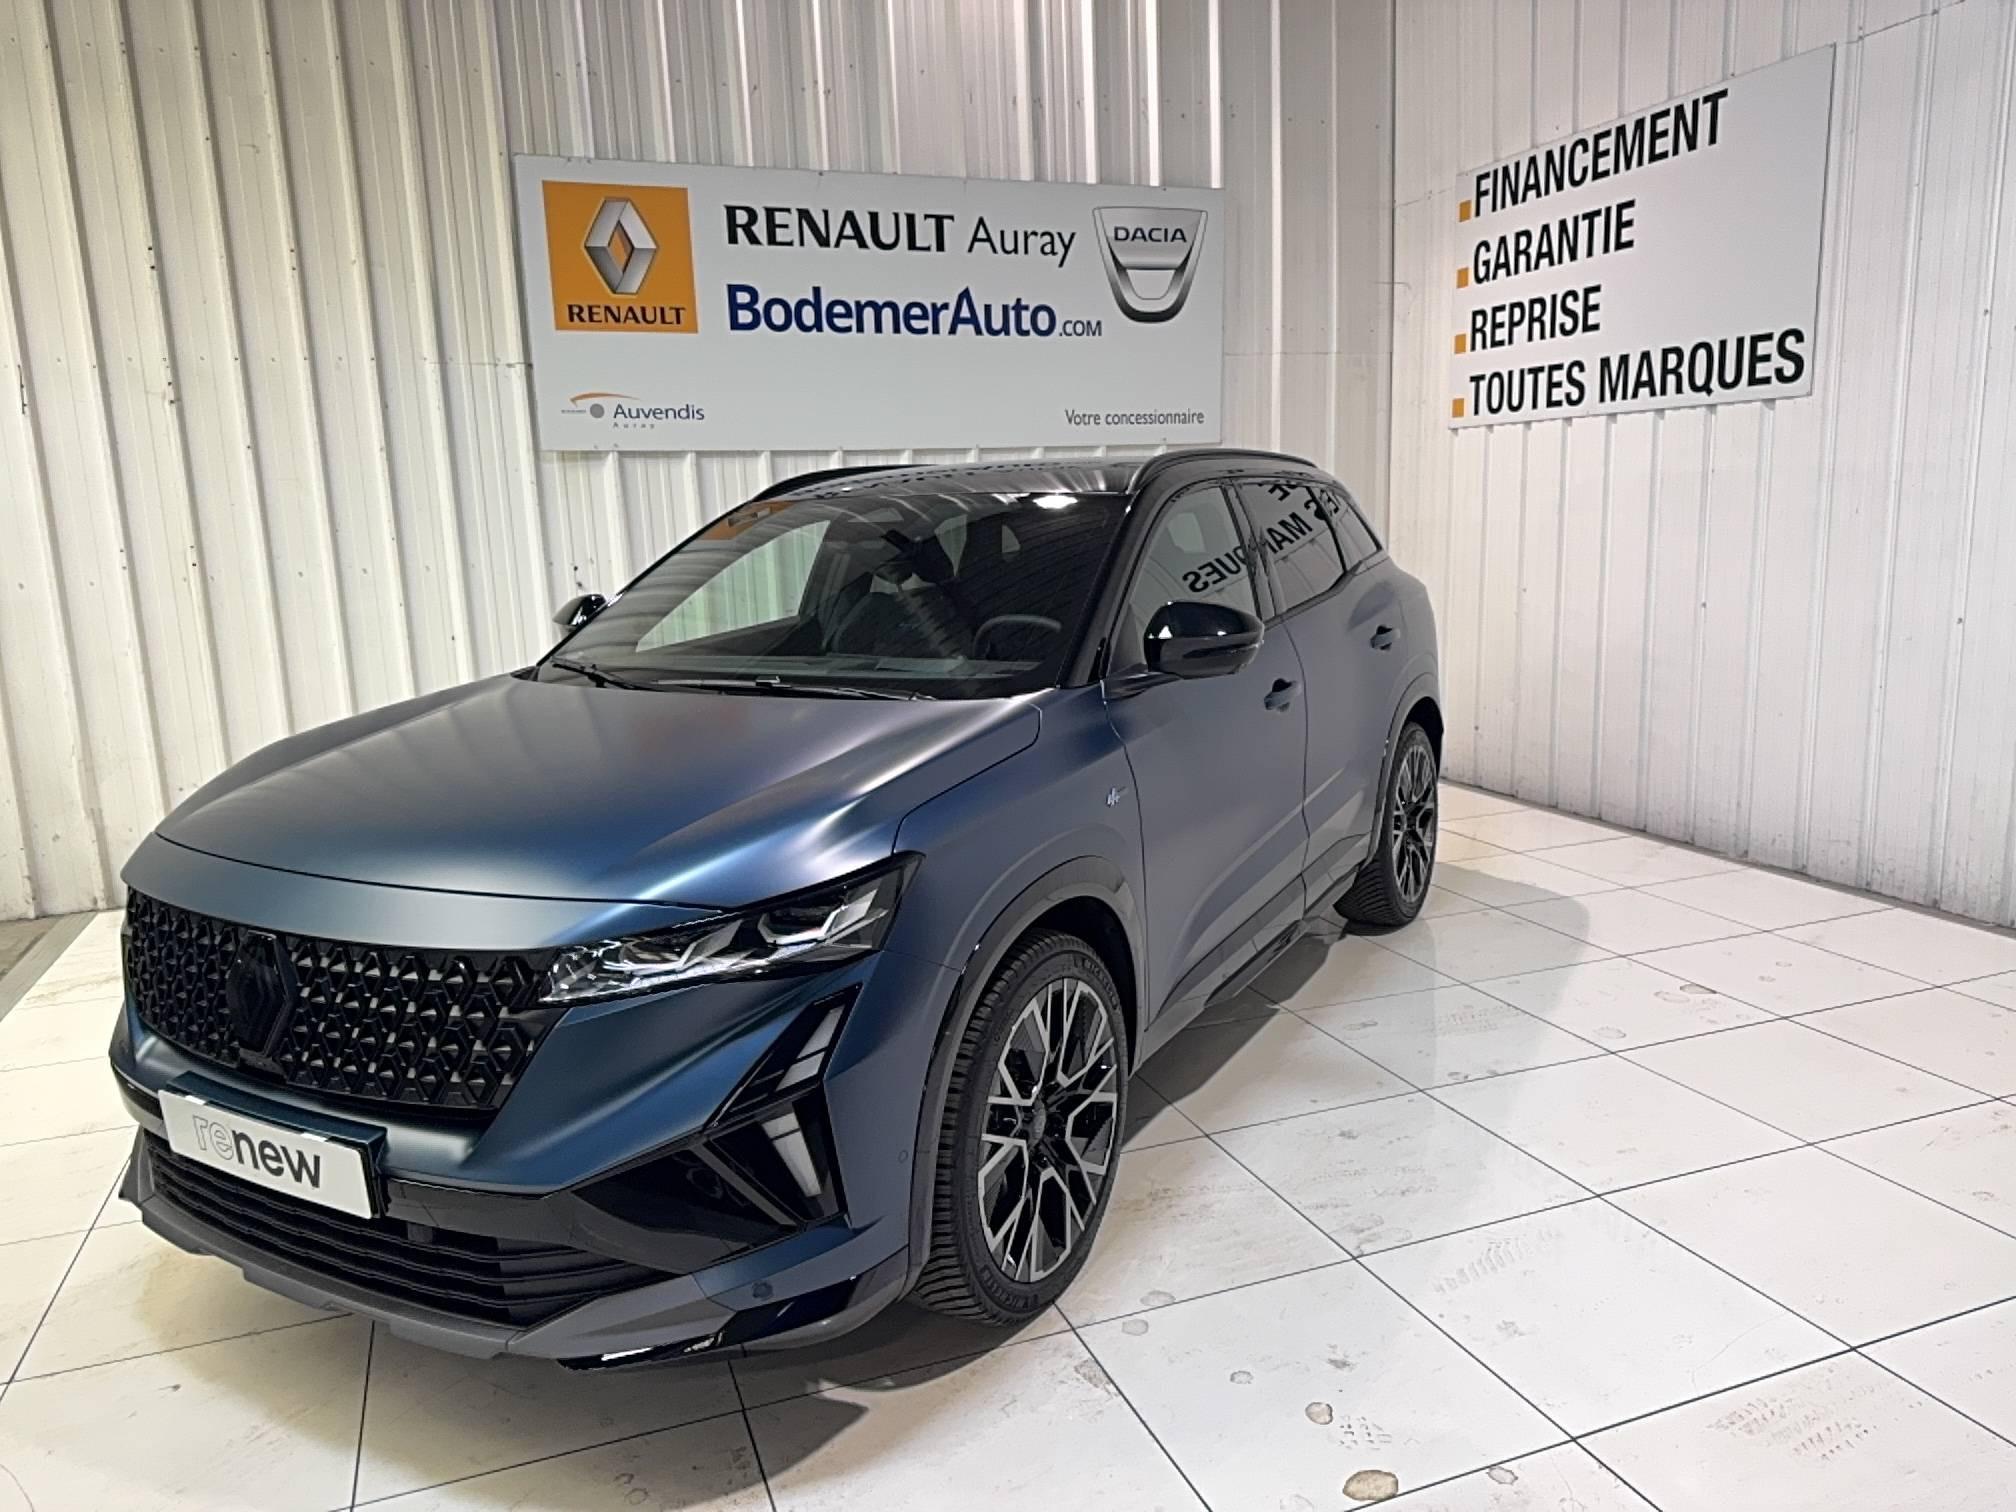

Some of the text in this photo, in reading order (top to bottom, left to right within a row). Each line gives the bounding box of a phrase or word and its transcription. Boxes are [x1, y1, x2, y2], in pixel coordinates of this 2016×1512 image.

[1473, 88, 1729, 218] FINANCEMENT
[723, 204, 1076, 268] RENAULT Auray
[1113, 225, 1188, 243] DACIA
[1473, 198, 1636, 285] GARANTIE
[567, 303, 687, 325] RENAULT
[1470, 284, 1602, 352] REPRISE
[1469, 327, 1805, 417] TOUTES MARQUES
[613, 403, 705, 420] Auvendis
[1065, 408, 1205, 426] Votre concessionnaire
[193, 1115, 321, 1188] renew
